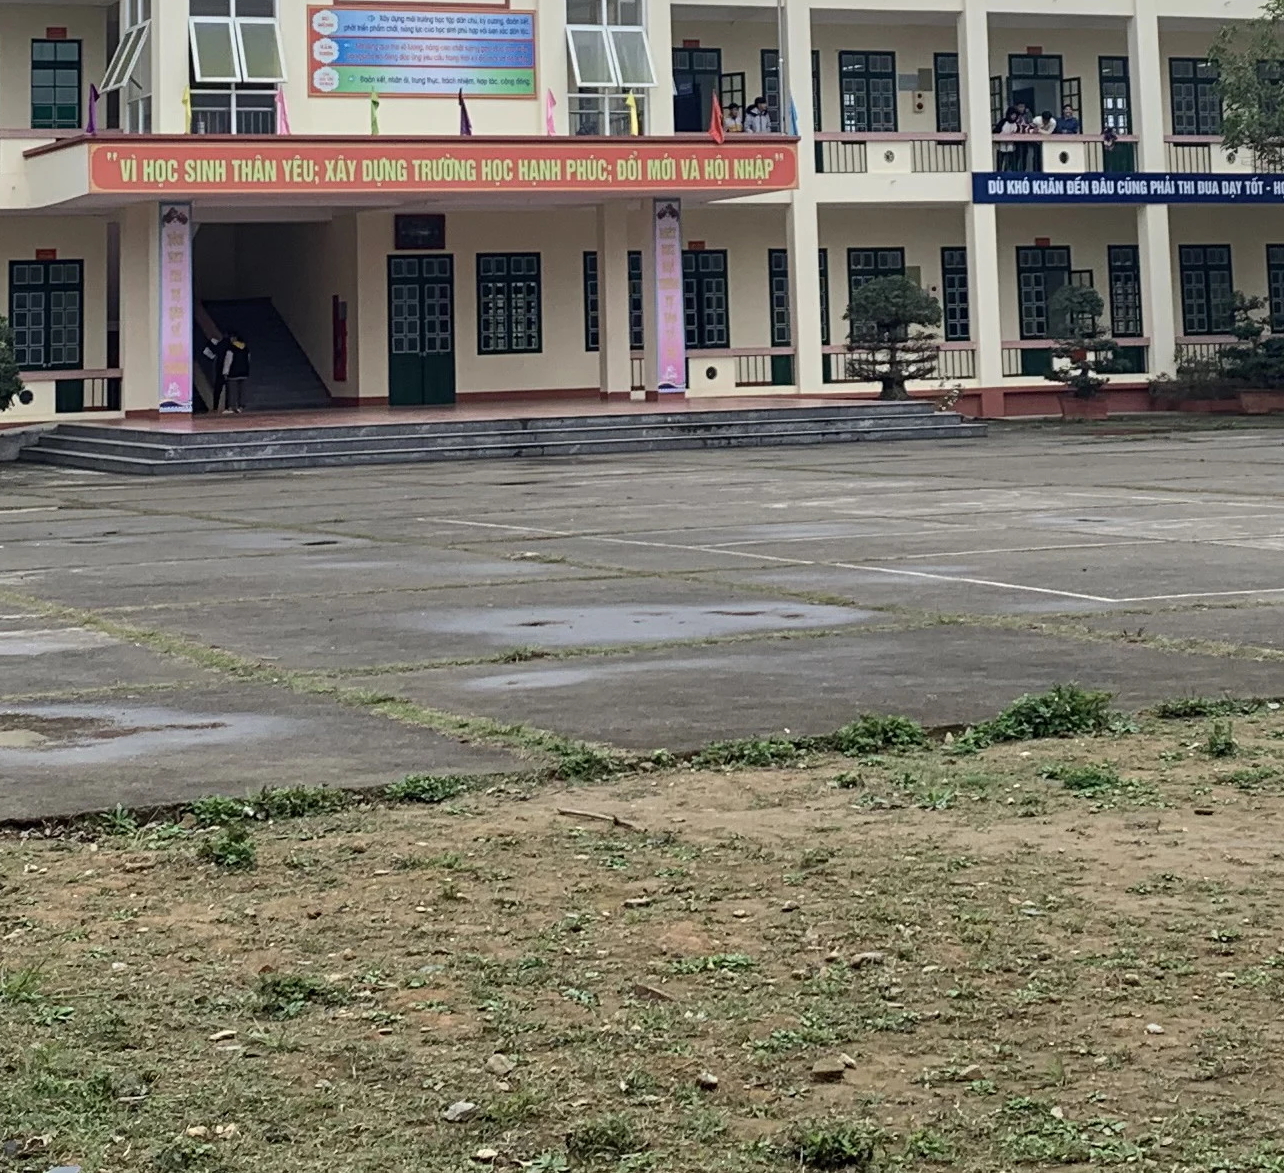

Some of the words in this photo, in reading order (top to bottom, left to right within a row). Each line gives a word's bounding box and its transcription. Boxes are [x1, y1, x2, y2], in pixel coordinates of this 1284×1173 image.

[142, 158, 178, 188] HỌC
[184, 158, 227, 183] SINH
[231, 154, 277, 183] THÂN
[282, 154, 319, 185] YÊU;
[324, 154, 357, 182] XÂY
[362, 157, 408, 187] DỰNG
[412, 153, 477, 182] TRƯỜNG
[481, 158, 513, 186] HỌC
[518, 158, 562, 186] HẠNH
[566, 154, 612, 184] PHÚC;
[617, 151, 642, 181] ĐỔI
[646, 153, 676, 181] MỚI
[680, 155, 701, 180] VÀ
[704, 154, 730, 185] HỘI
[1006, 177, 1030, 194] KHÓ
[1032, 177, 1064, 195] KHĂN
[1065, 176, 1089, 195] ĐẾN
[1091, 177, 1114, 195] ĐÂU
[1116, 177, 1148, 195] CŨNG
[1149, 175, 1175, 195] PHẢI
[1177, 180, 1195, 195] THI
[1197, 180, 1220, 195] ĐUA
[1221, 180, 1242, 198] DẠY
[1244, 177, 1264, 195] TỐT
